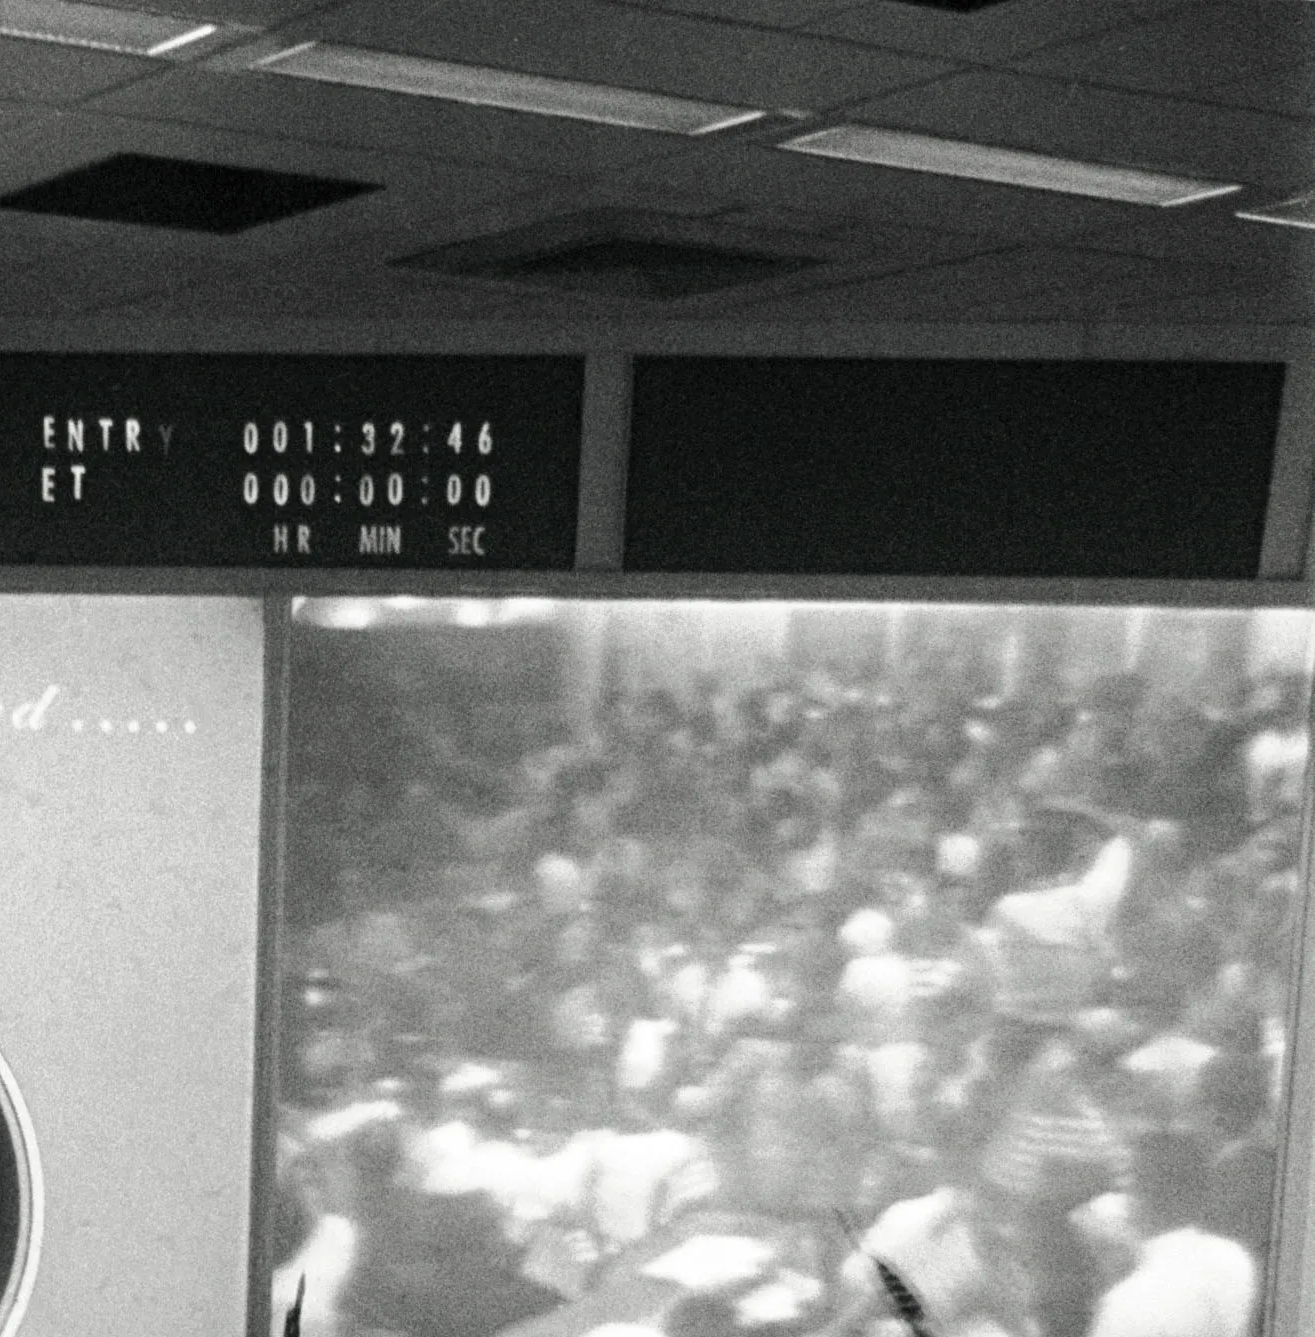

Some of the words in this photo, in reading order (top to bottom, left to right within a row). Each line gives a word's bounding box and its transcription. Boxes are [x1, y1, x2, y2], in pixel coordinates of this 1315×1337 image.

[43, 416, 174, 455] ENTRY
[41, 465, 86, 502] ET
[243, 472, 492, 506] 000:00:00
[274, 524, 312, 555] HR
[358, 524, 402, 555] MIN
[448, 524, 486, 556] SEC
